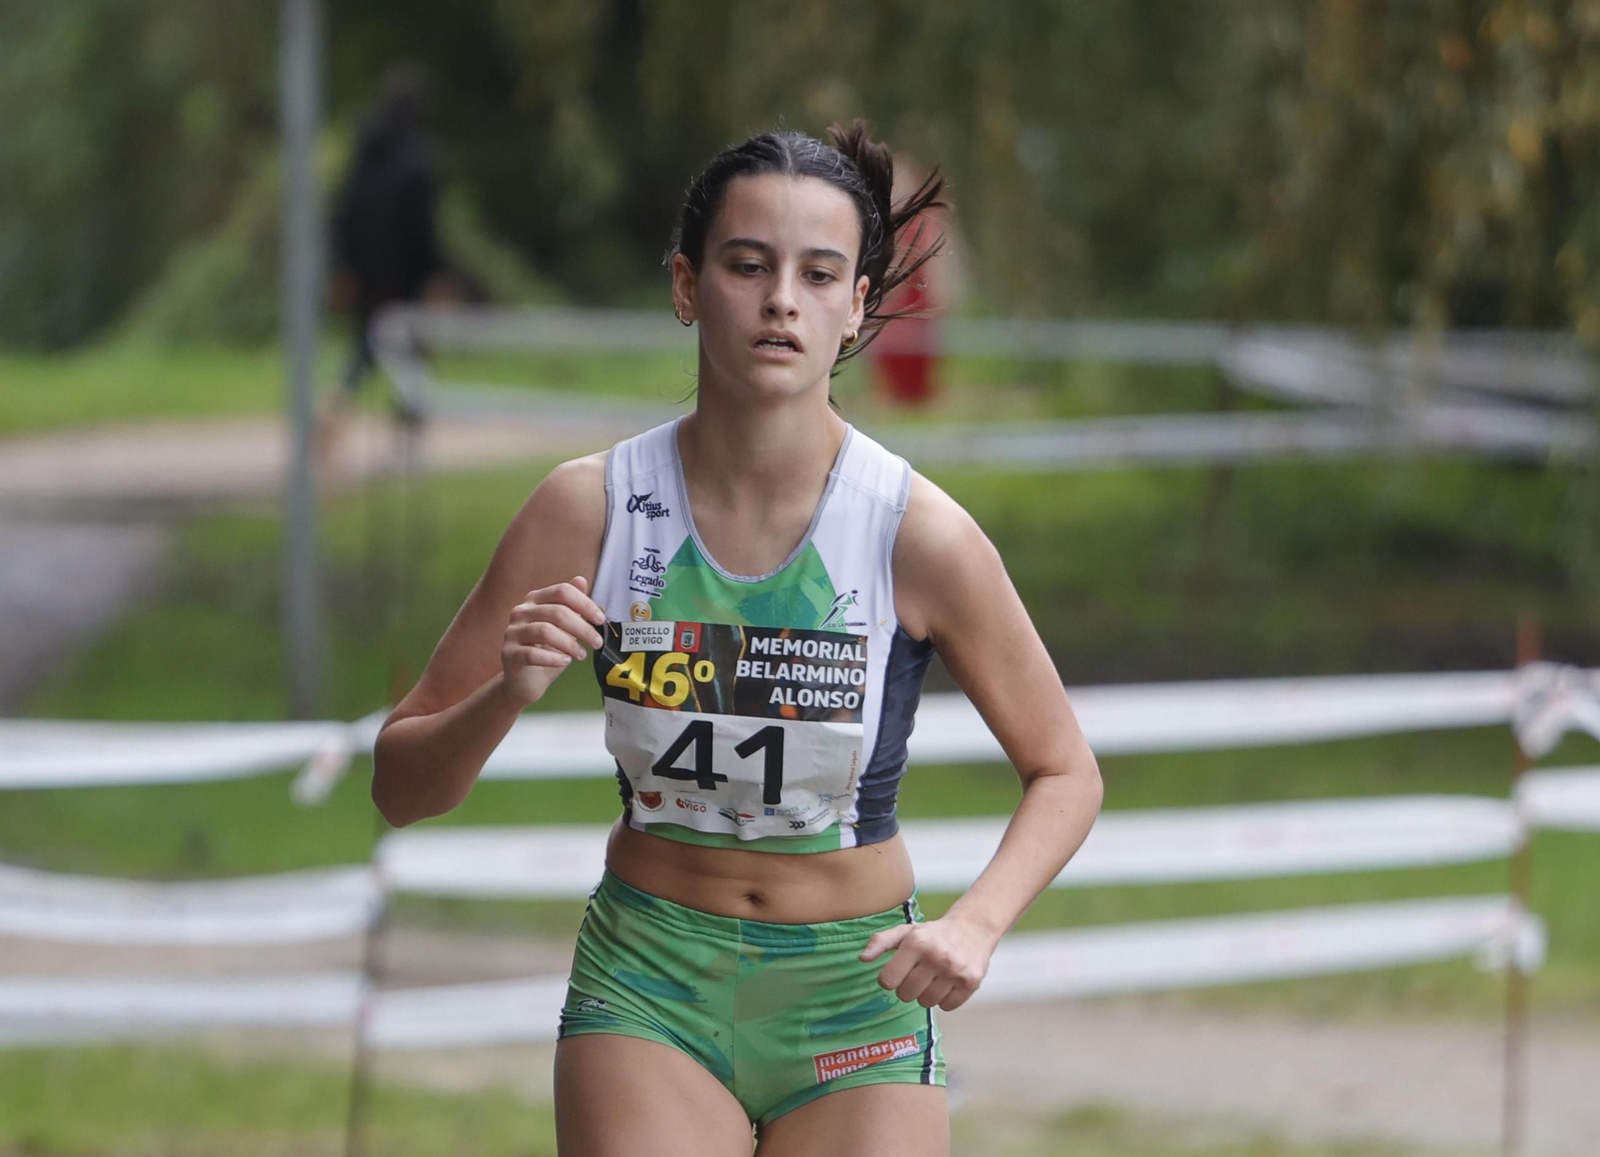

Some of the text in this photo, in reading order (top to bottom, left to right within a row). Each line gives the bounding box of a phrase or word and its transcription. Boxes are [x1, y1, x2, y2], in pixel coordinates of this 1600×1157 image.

[646, 508, 670, 521] sport
[629, 569, 665, 587] Legado
[625, 627, 670, 636] CONCELLO
[629, 636, 663, 645] DE VIGO
[750, 637, 867, 662] MEMORIAL
[736, 660, 866, 686] BELARMINO
[769, 687, 860, 709] ALONSO
[651, 720, 785, 805] 41
[684, 801, 707, 813] VIGO
[819, 1038, 914, 1068] mandarina
